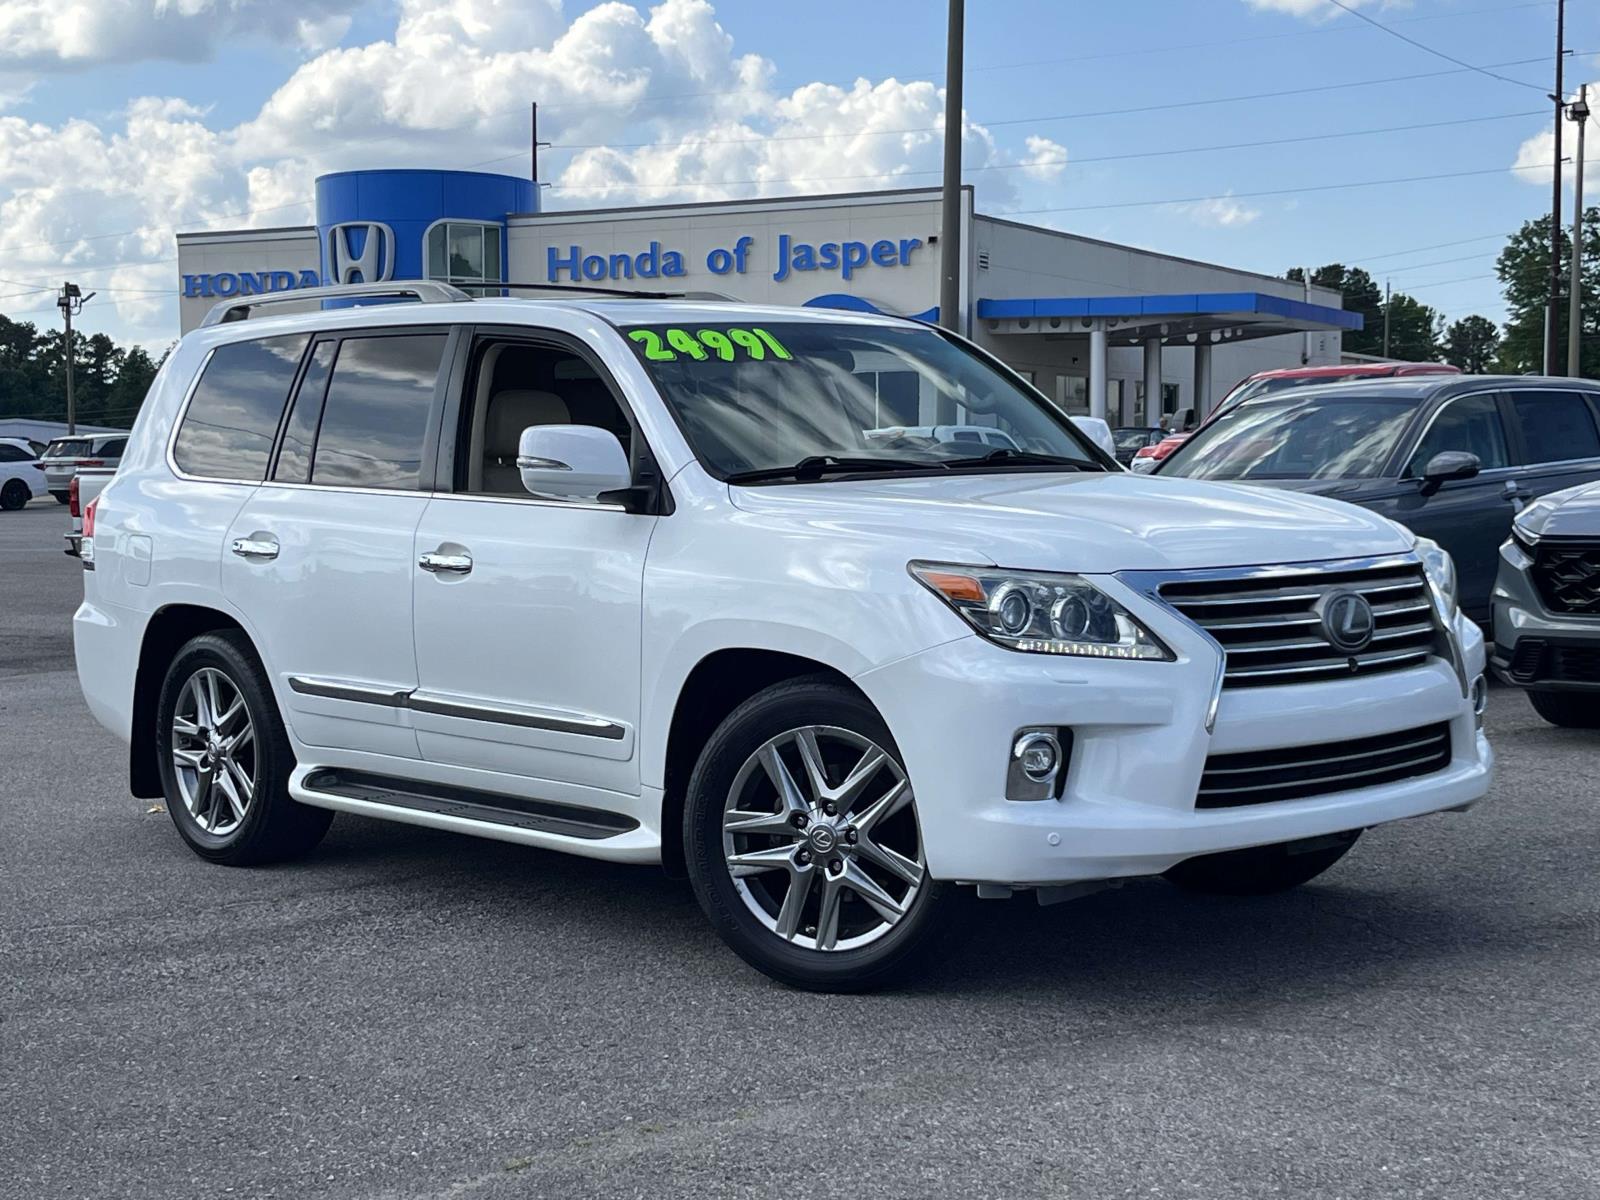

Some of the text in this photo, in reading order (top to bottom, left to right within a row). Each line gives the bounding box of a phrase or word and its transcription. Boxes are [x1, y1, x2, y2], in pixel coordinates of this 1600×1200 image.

[546, 234, 923, 282] Honda of Jasper
[182, 269, 320, 298] HONDA
[628, 328, 793, 362] 24991
